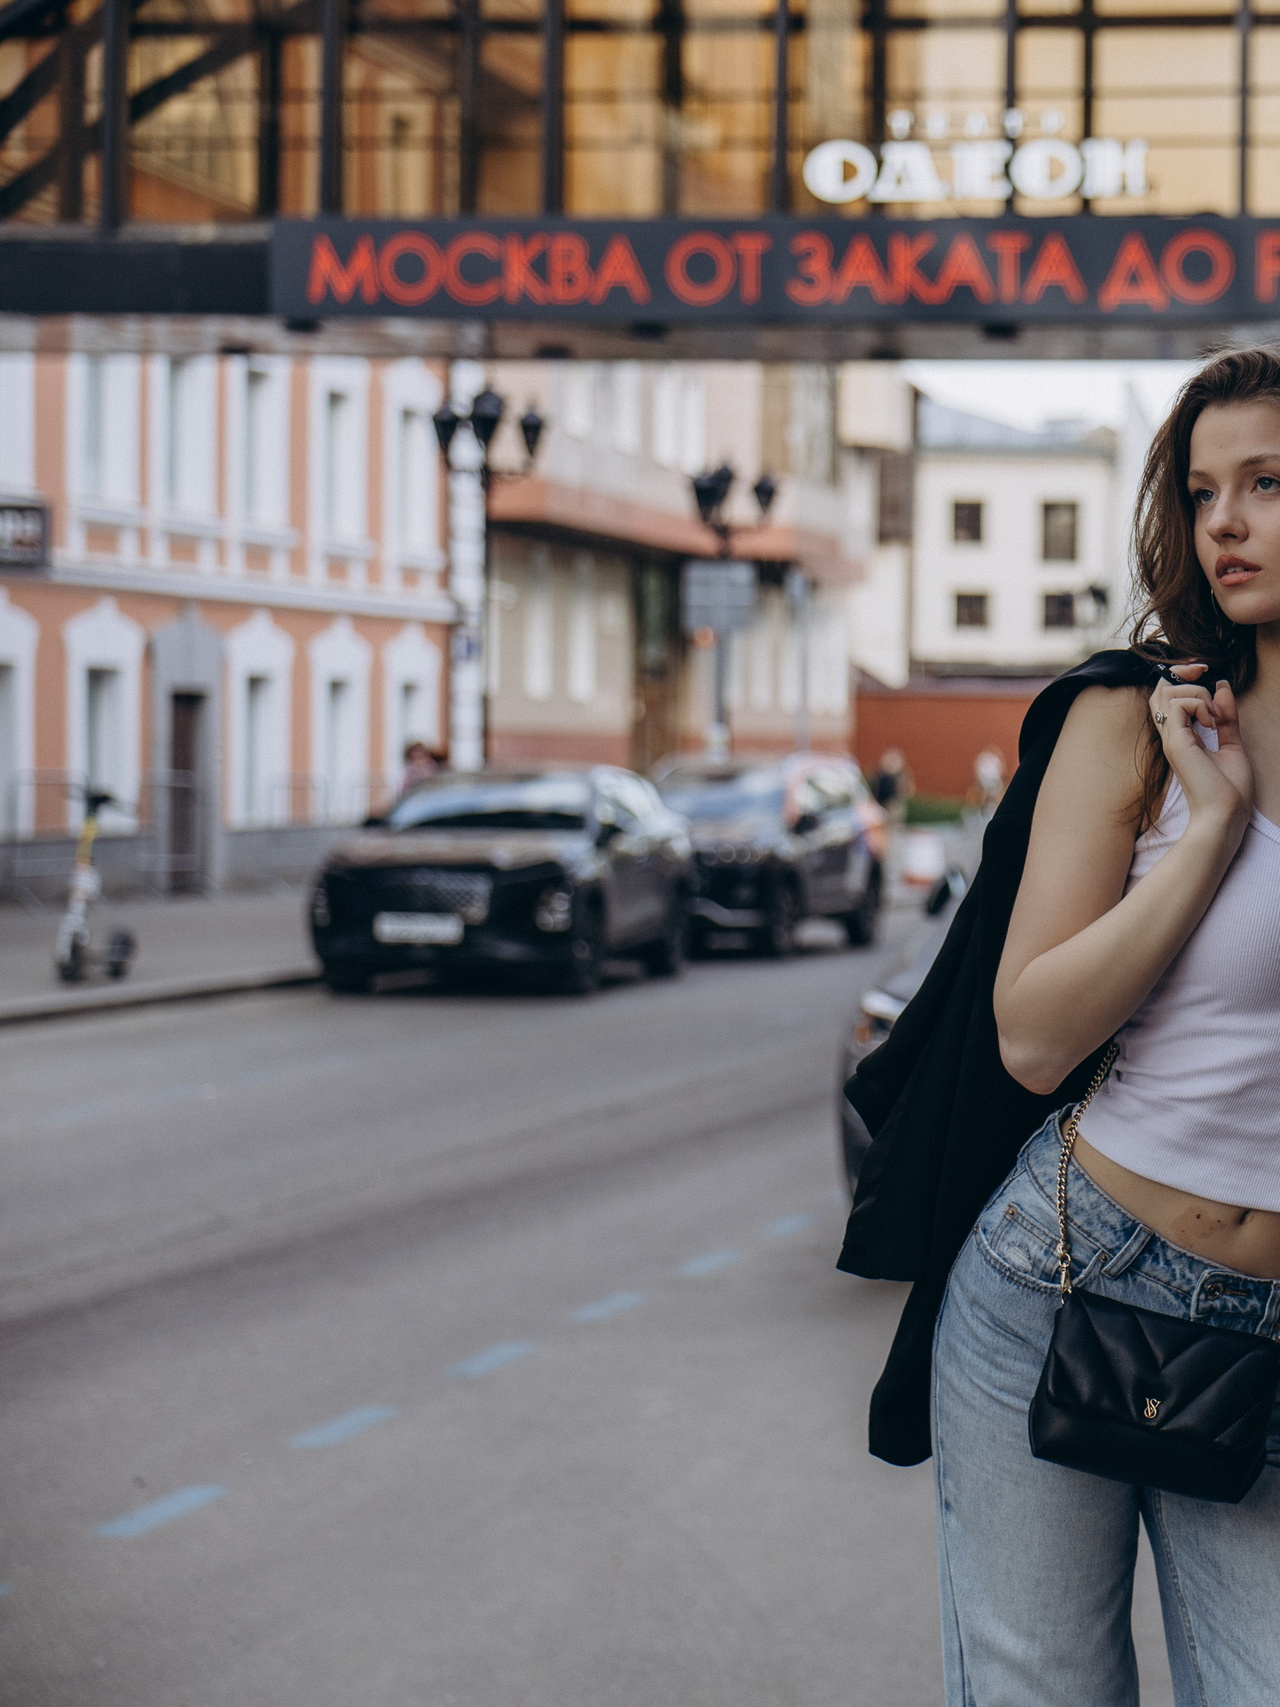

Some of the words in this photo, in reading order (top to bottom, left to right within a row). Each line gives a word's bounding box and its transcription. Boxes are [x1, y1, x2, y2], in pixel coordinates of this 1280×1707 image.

[803, 138, 1149, 204] ОДЕОН
[308, 232, 651, 306] МОСКВА
[666, 231, 771, 306] ОТ
[787, 230, 1087, 306] ЗАКАТА
[1098, 229, 1235, 312] ДО
